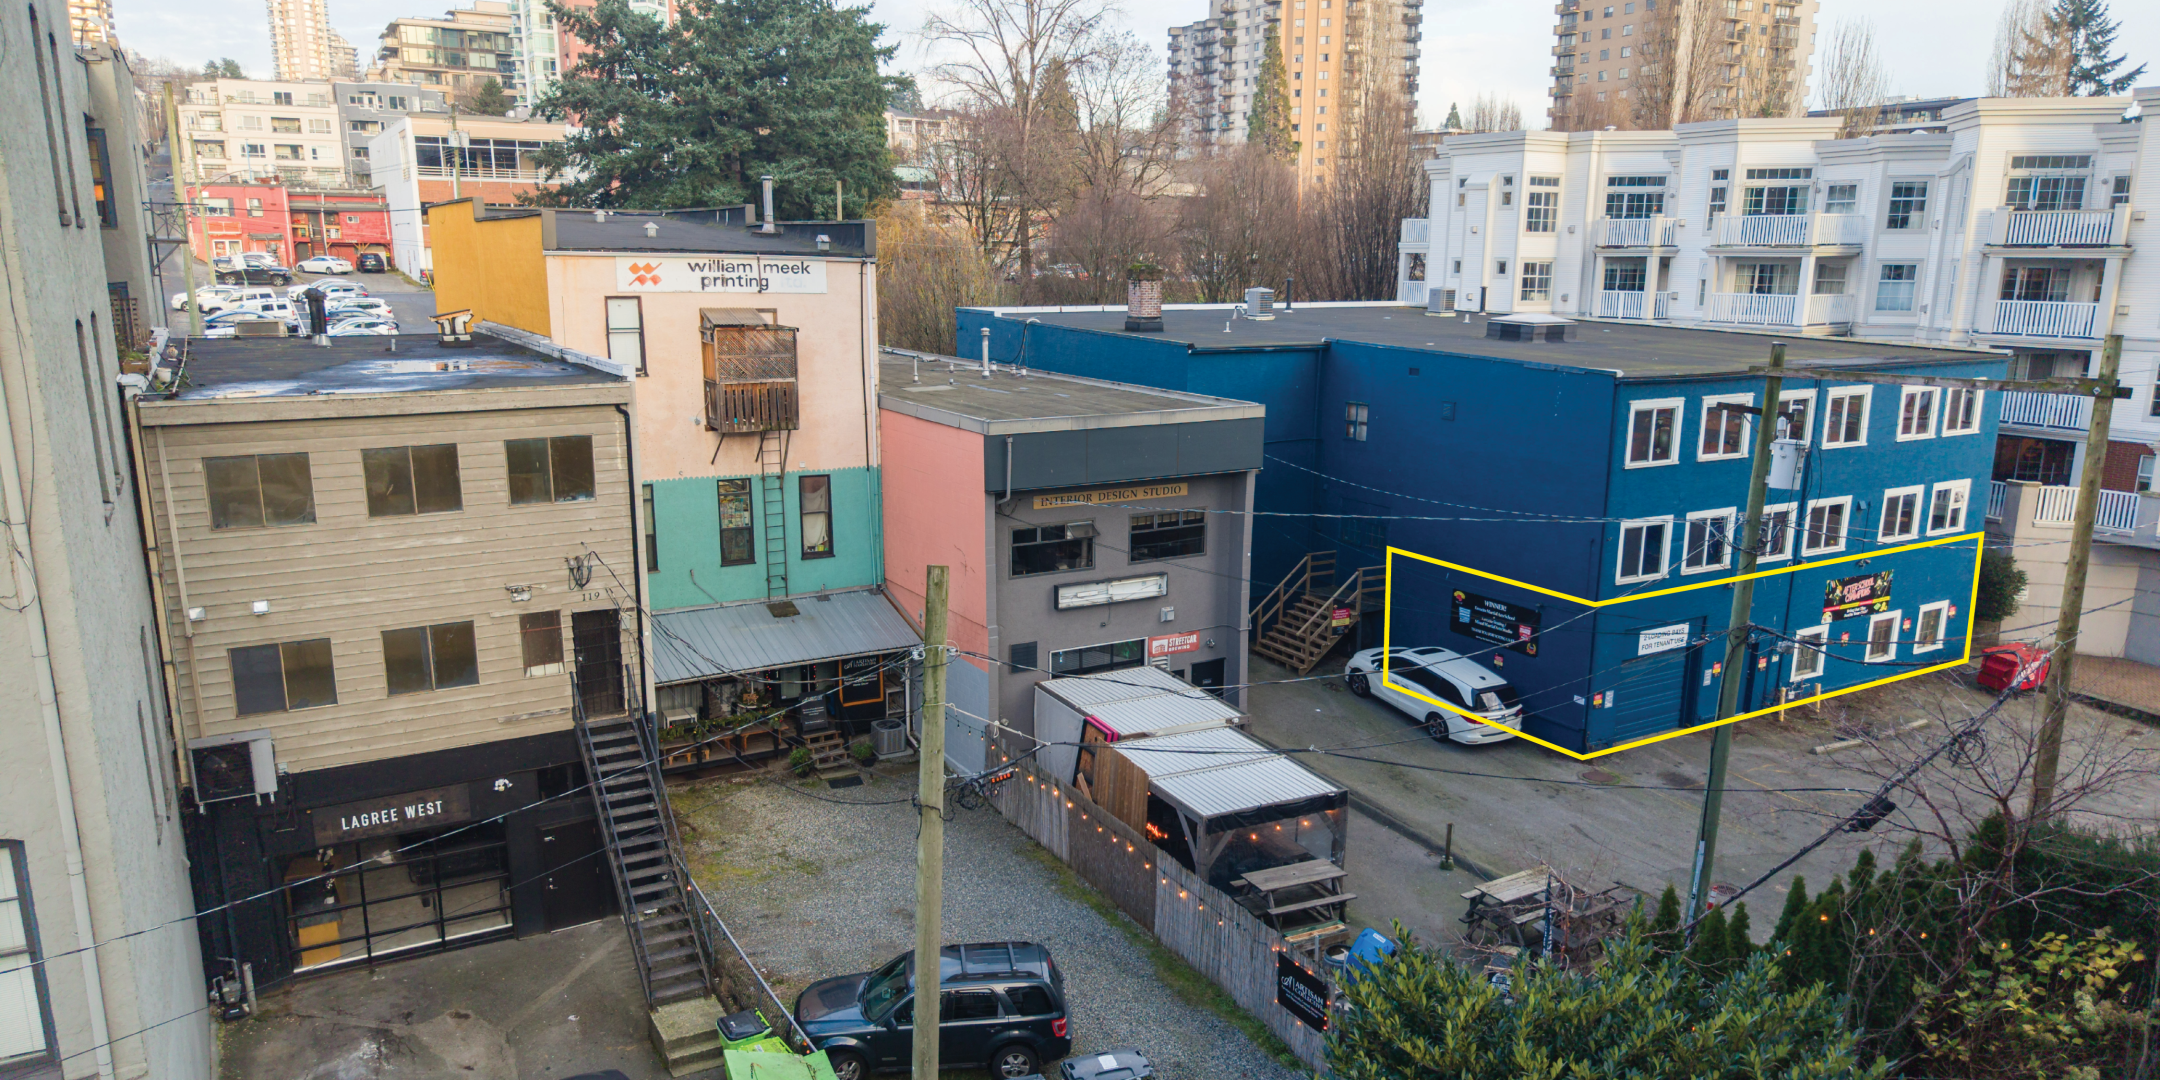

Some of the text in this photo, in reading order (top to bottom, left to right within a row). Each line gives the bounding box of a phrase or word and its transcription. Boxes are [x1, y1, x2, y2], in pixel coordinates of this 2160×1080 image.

[687, 259, 810, 275] william meek
[701, 274, 769, 291] printing
[1040, 485, 1181, 507] INTERIOR DESIGN STUDIO
[582, 591, 600, 602] 119
[1169, 634, 1197, 646] STREETCAR
[1648, 630, 1670, 640] LOADING
[1654, 638, 1673, 648] TENANT
[341, 800, 443, 830] LAGREE WEST
[1295, 981, 1324, 1006] ARTISAN
